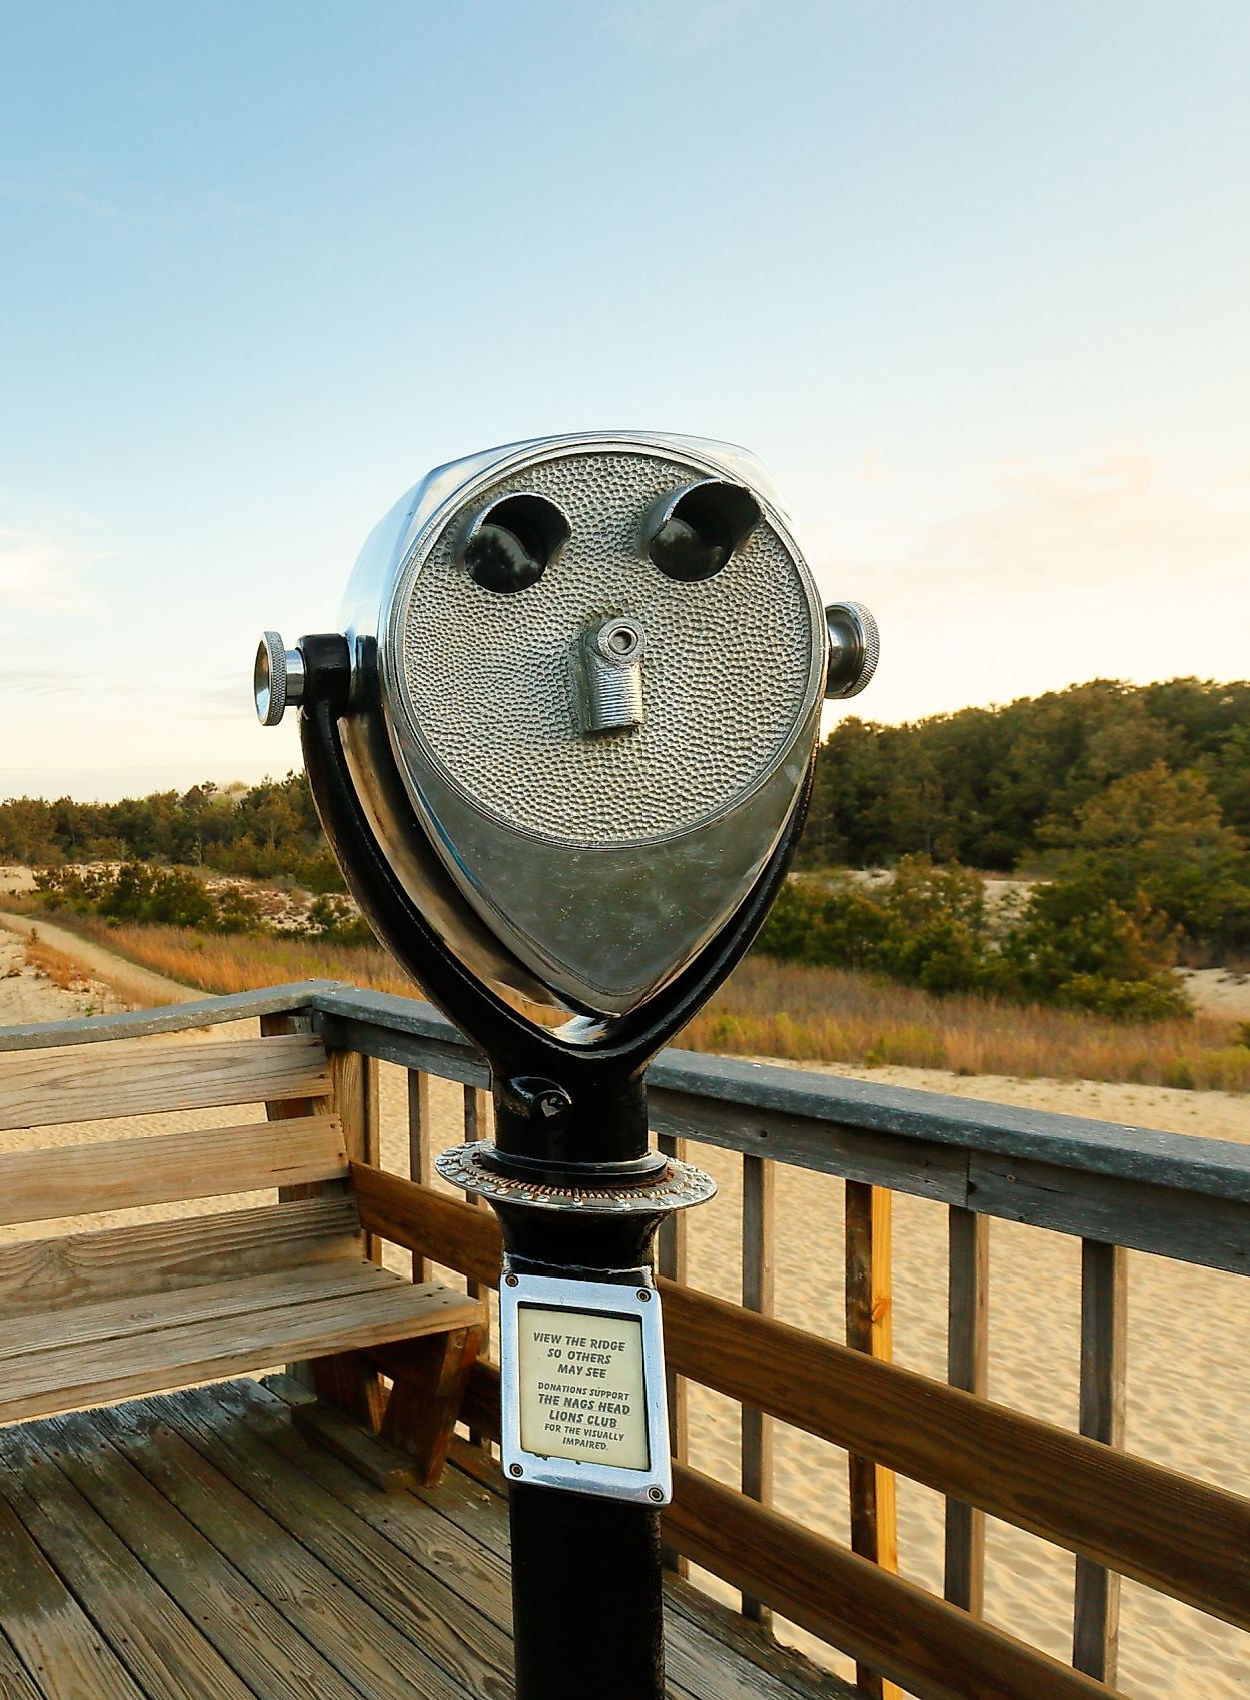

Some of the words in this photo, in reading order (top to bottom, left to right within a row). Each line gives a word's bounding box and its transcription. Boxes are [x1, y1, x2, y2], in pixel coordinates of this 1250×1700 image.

[533, 1332, 562, 1344] VIEW
[565, 1335, 586, 1347] THE
[590, 1339, 625, 1351] RIDGE
[547, 1348, 562, 1358] SO
[567, 1351, 611, 1364] OTHERS
[558, 1364, 583, 1375] MAY
[586, 1367, 606, 1378] SEE
[538, 1382, 587, 1395] DONATIONS
[589, 1389, 629, 1401] SUPPORT
[538, 1394, 560, 1406] THE
[564, 1397, 594, 1410] NAGS
[598, 1402, 630, 1415] HEAD
[549, 1410, 583, 1423] LIONS
[587, 1415, 617, 1428] CLUB
[545, 1423, 561, 1432] FOR
[564, 1426, 581, 1435] THE
[584, 1429, 624, 1441] VISUALLY
[562, 1437, 608, 1450] IMPAIRED.
